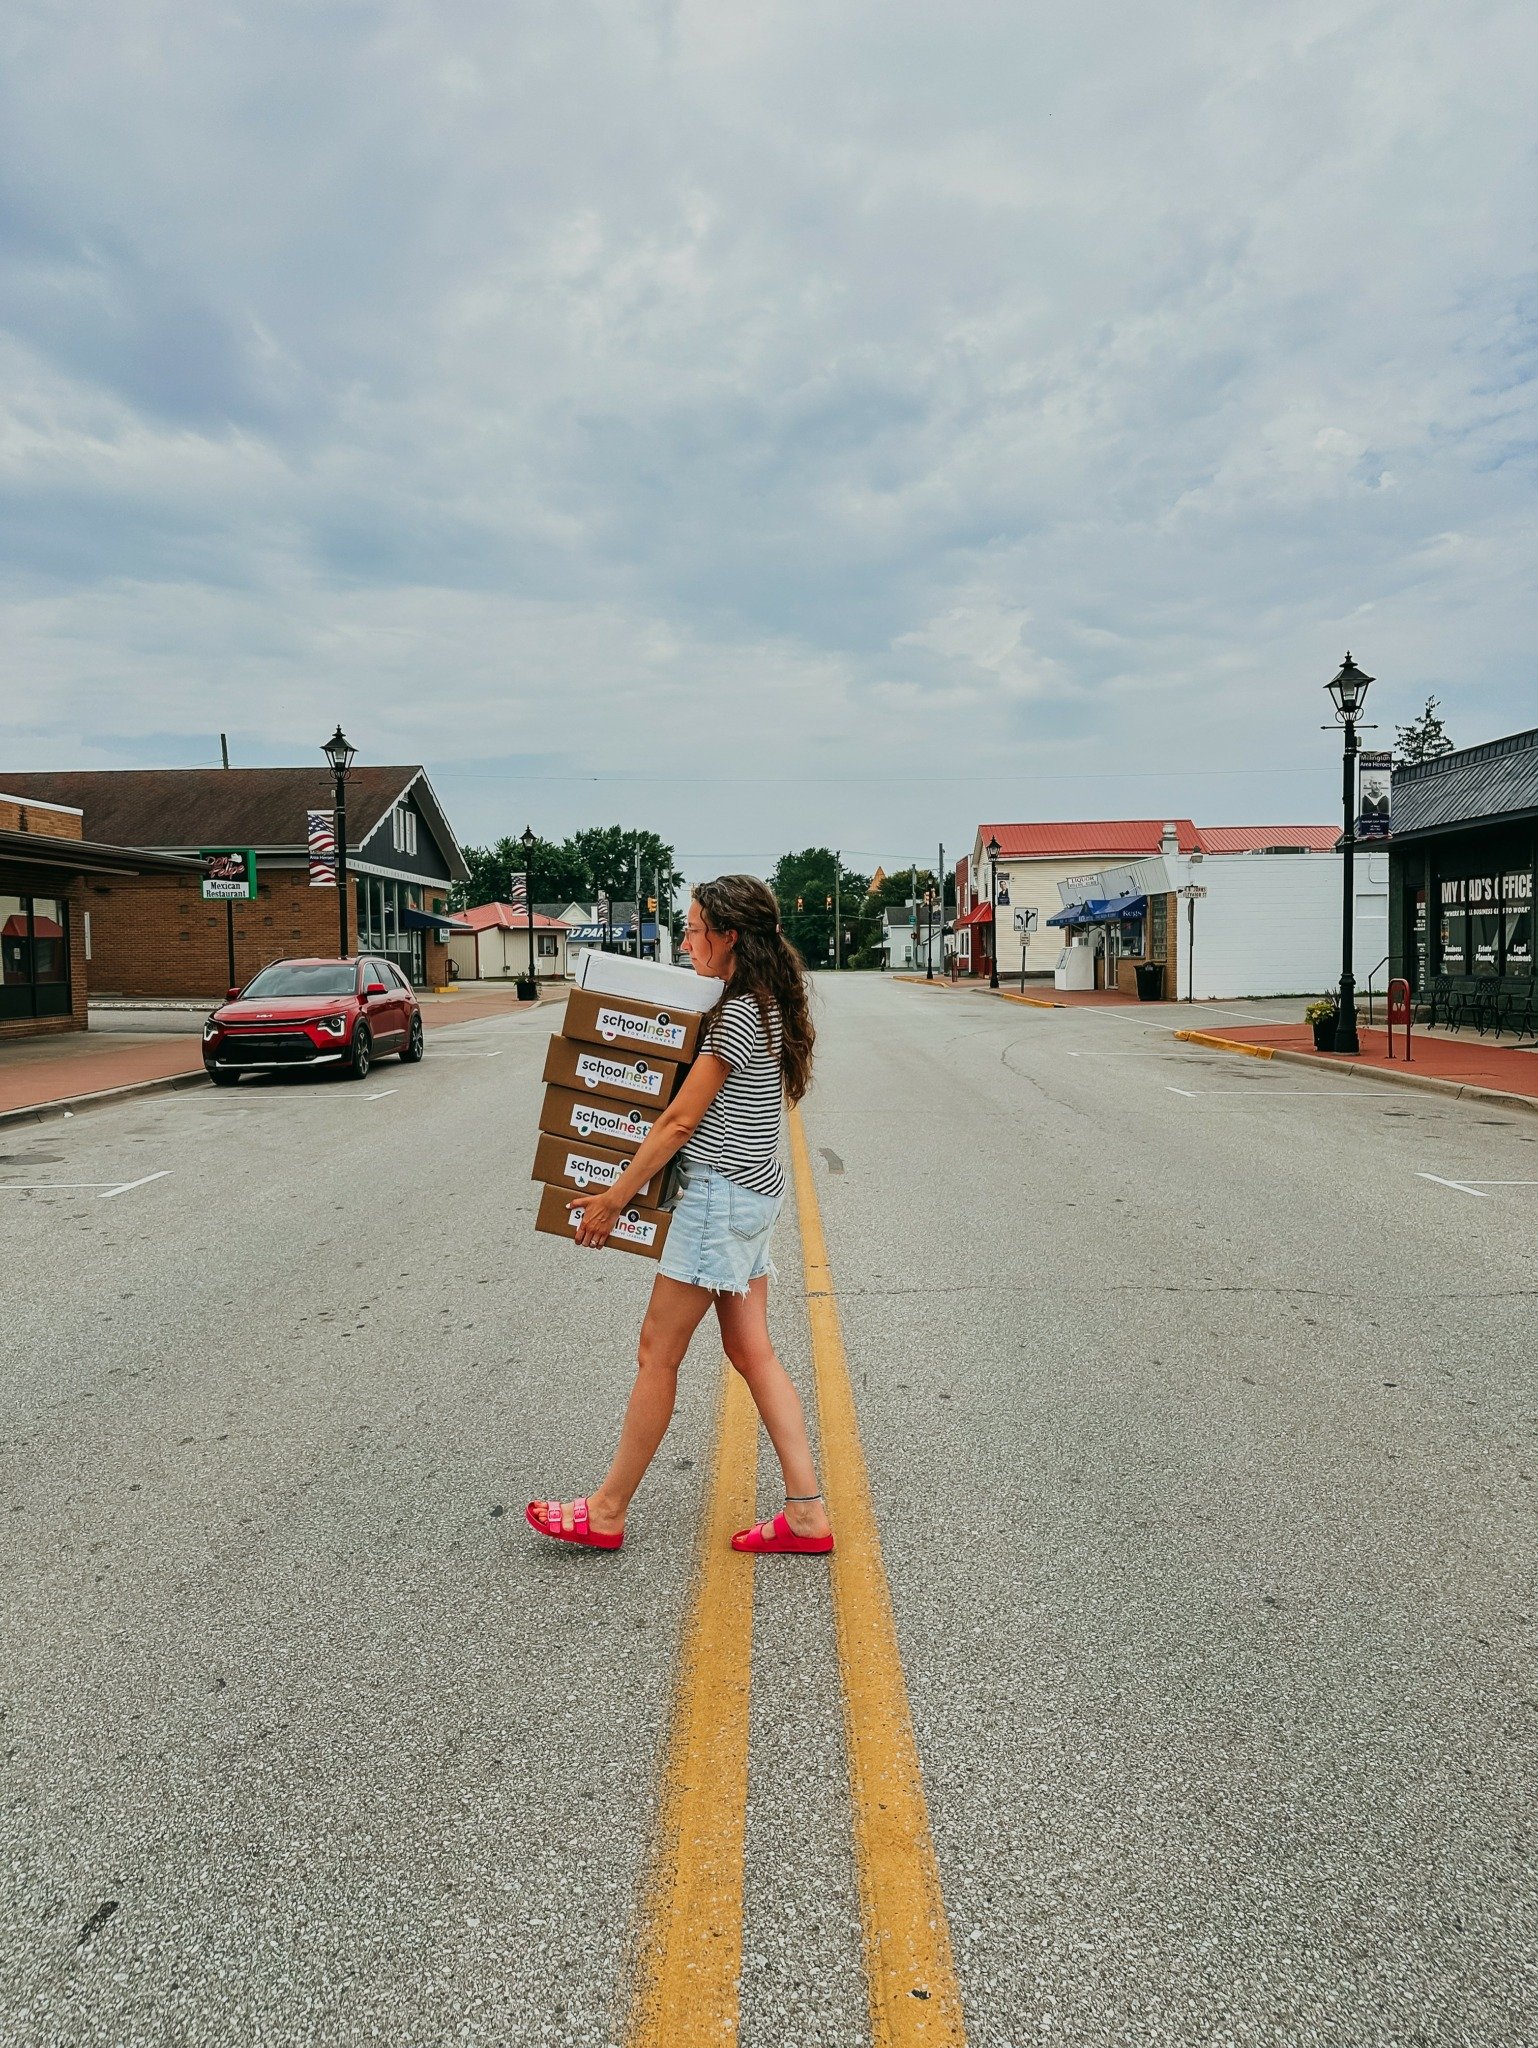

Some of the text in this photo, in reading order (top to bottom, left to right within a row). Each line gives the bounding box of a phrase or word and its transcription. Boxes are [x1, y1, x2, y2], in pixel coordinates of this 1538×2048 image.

[206, 856, 228, 865] Don
[208, 862, 245, 879] Felipe
[1442, 881, 1458, 903] MY
[571, 1160, 621, 1179] schooln
